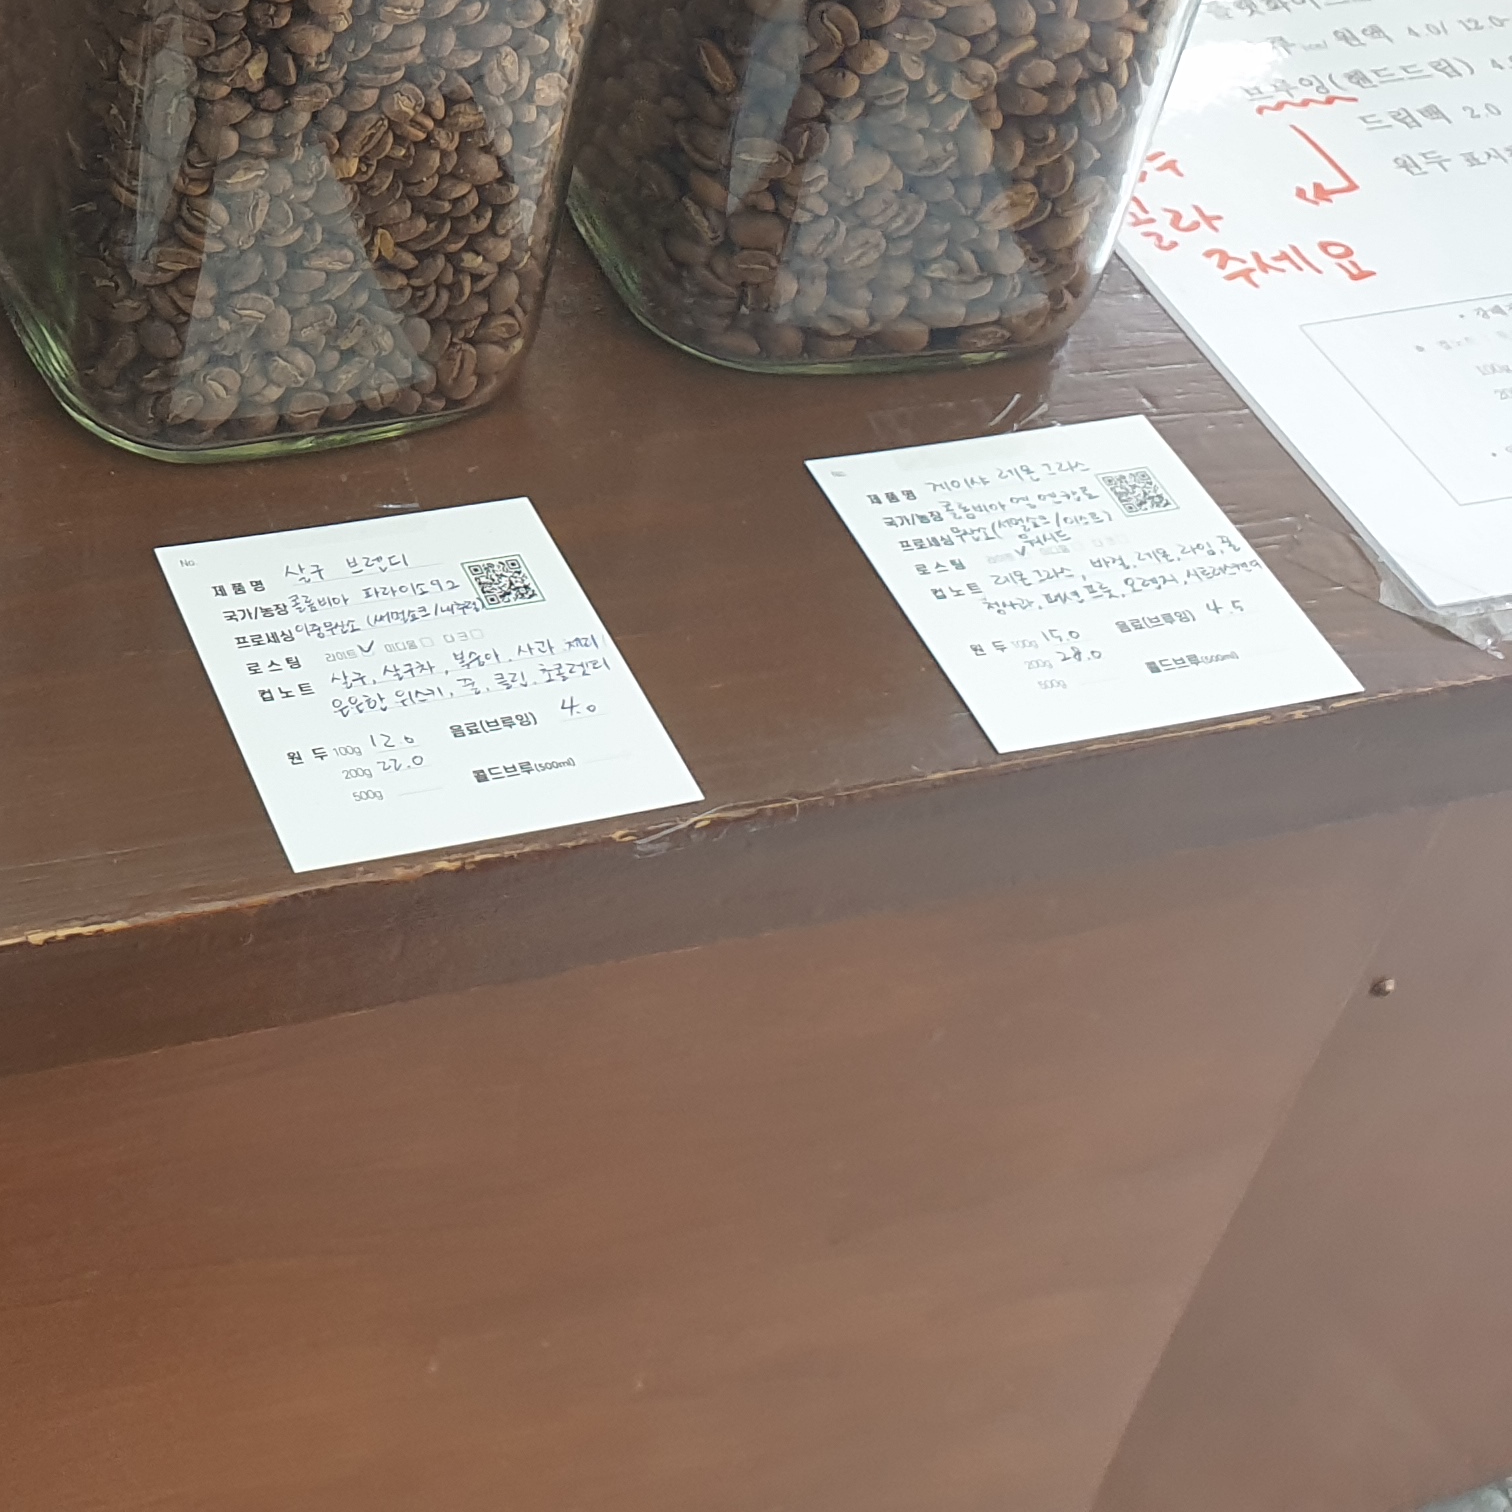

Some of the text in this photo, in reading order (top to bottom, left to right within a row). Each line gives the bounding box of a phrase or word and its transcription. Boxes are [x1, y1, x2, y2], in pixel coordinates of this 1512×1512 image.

[1359, 102, 1502, 131] 드립백 2.0
[1392, 151, 1453, 176] 원두
[1201, 239, 1377, 289] 주세요
[924, 475, 991, 493] 게이샤
[997, 464, 1041, 482] 레몬
[882, 510, 944, 528] 국가/농장
[898, 534, 955, 552] 프로세싱
[284, 563, 325, 584] 살구
[222, 602, 289, 623] 국가/농장
[288, 593, 350, 614] 콜롬비아
[234, 629, 296, 649] 프로세싱
[294, 619, 362, 639] 이중무산소
[1010, 639, 1039, 649] 100g
[1041, 628, 1081, 643] 15.0
[1114, 609, 1197, 634] 음료(브루잉)
[324, 649, 358, 663] 라이트
[1023, 658, 1054, 670] 200g
[331, 692, 388, 718] 은은한
[332, 745, 363, 757] 100g
[449, 711, 538, 739] 음료(브루잉)
[560, 696, 597, 716] 4.0
[341, 755, 424, 780] 200g 22.0
[352, 757, 576, 802] 500g 콜드브루(500ml)
